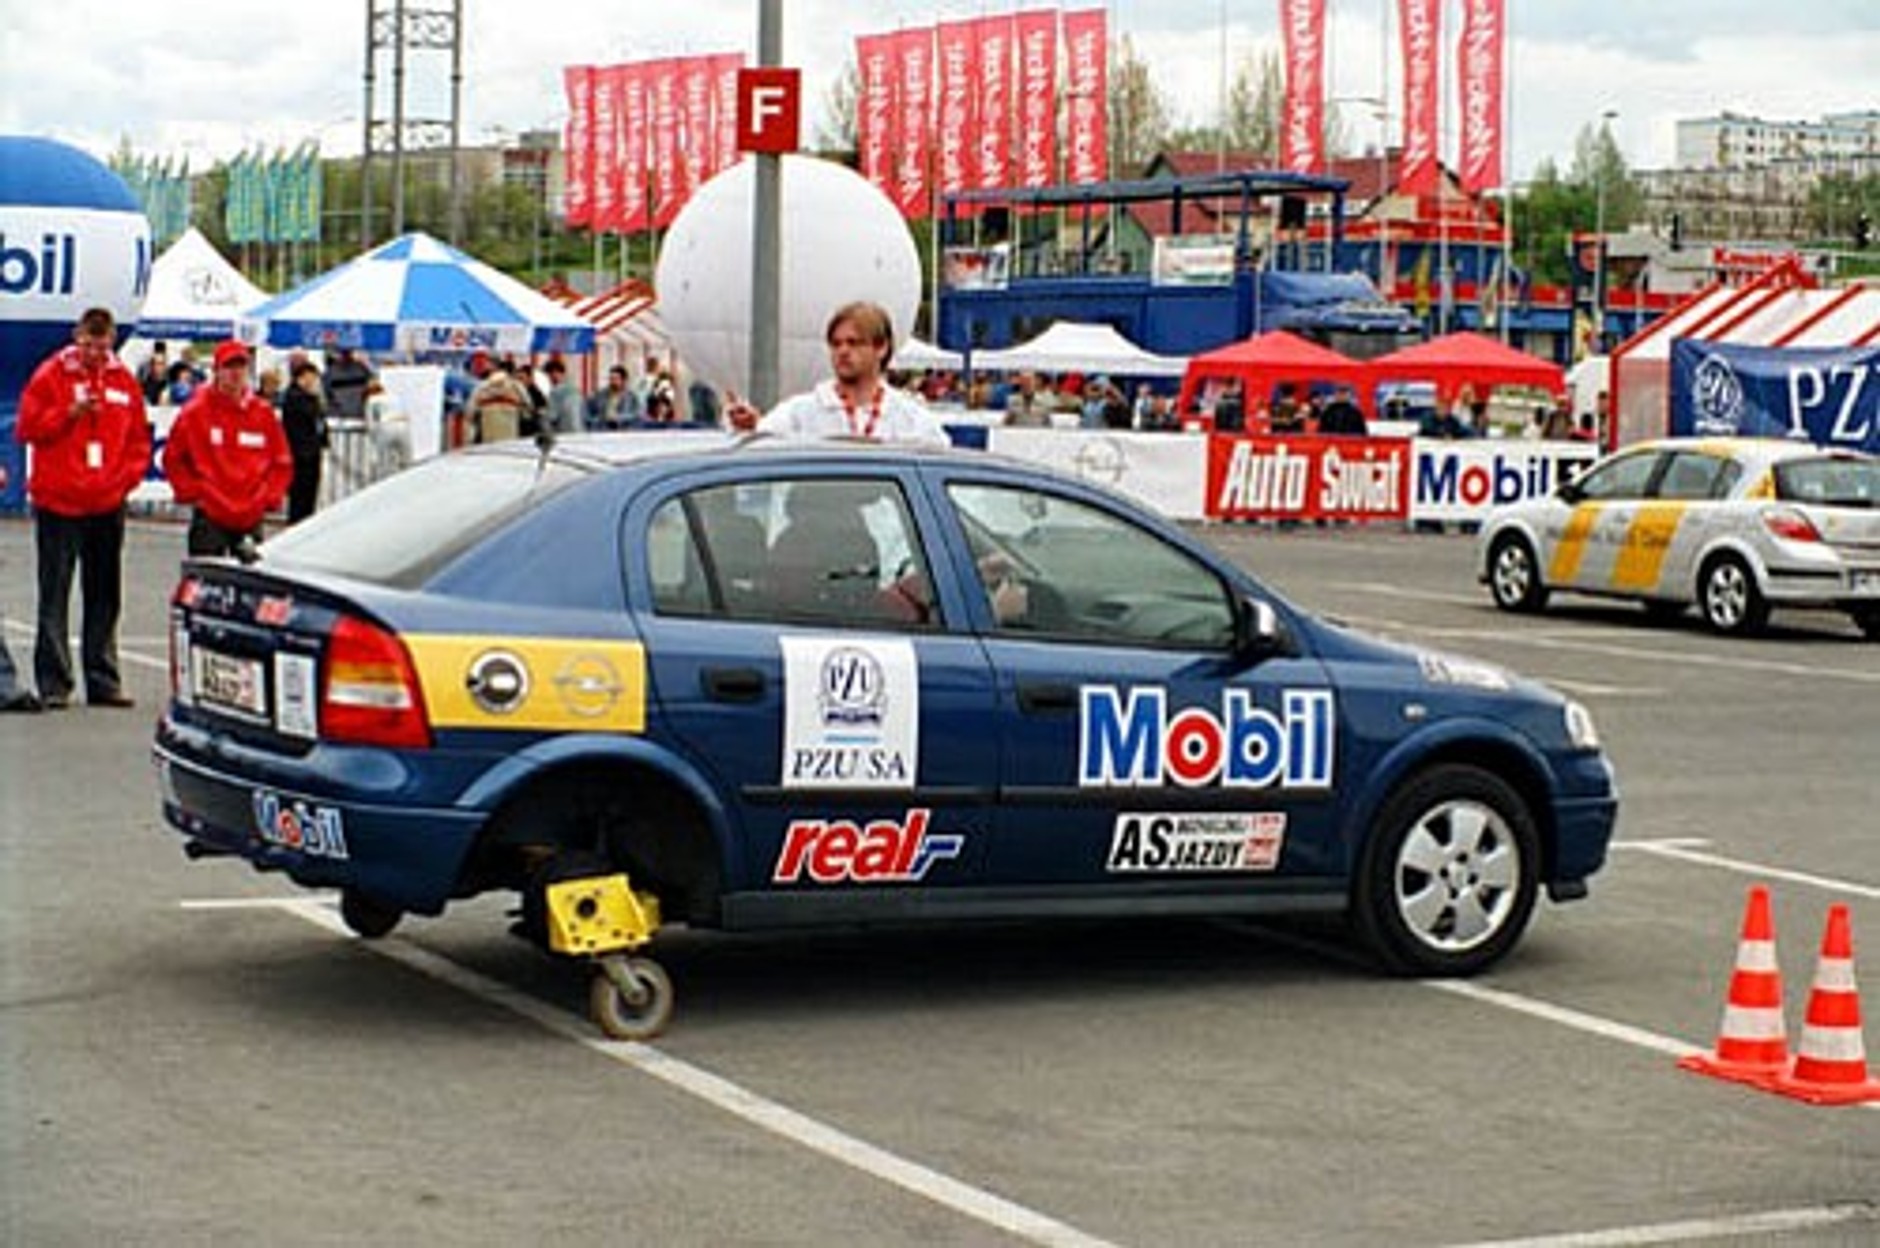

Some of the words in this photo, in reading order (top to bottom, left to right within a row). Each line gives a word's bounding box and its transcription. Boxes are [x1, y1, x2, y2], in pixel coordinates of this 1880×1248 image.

[752, 87, 786, 134] F
[1786, 364, 1880, 440] PZ
[1218, 440, 1309, 511] Auto
[1416, 454, 1550, 505] Mobil
[1080, 686, 1334, 787] Mobil
[793, 750, 859, 779] PZU
[867, 750, 907, 779] SA
[1111, 819, 1174, 867] AS
